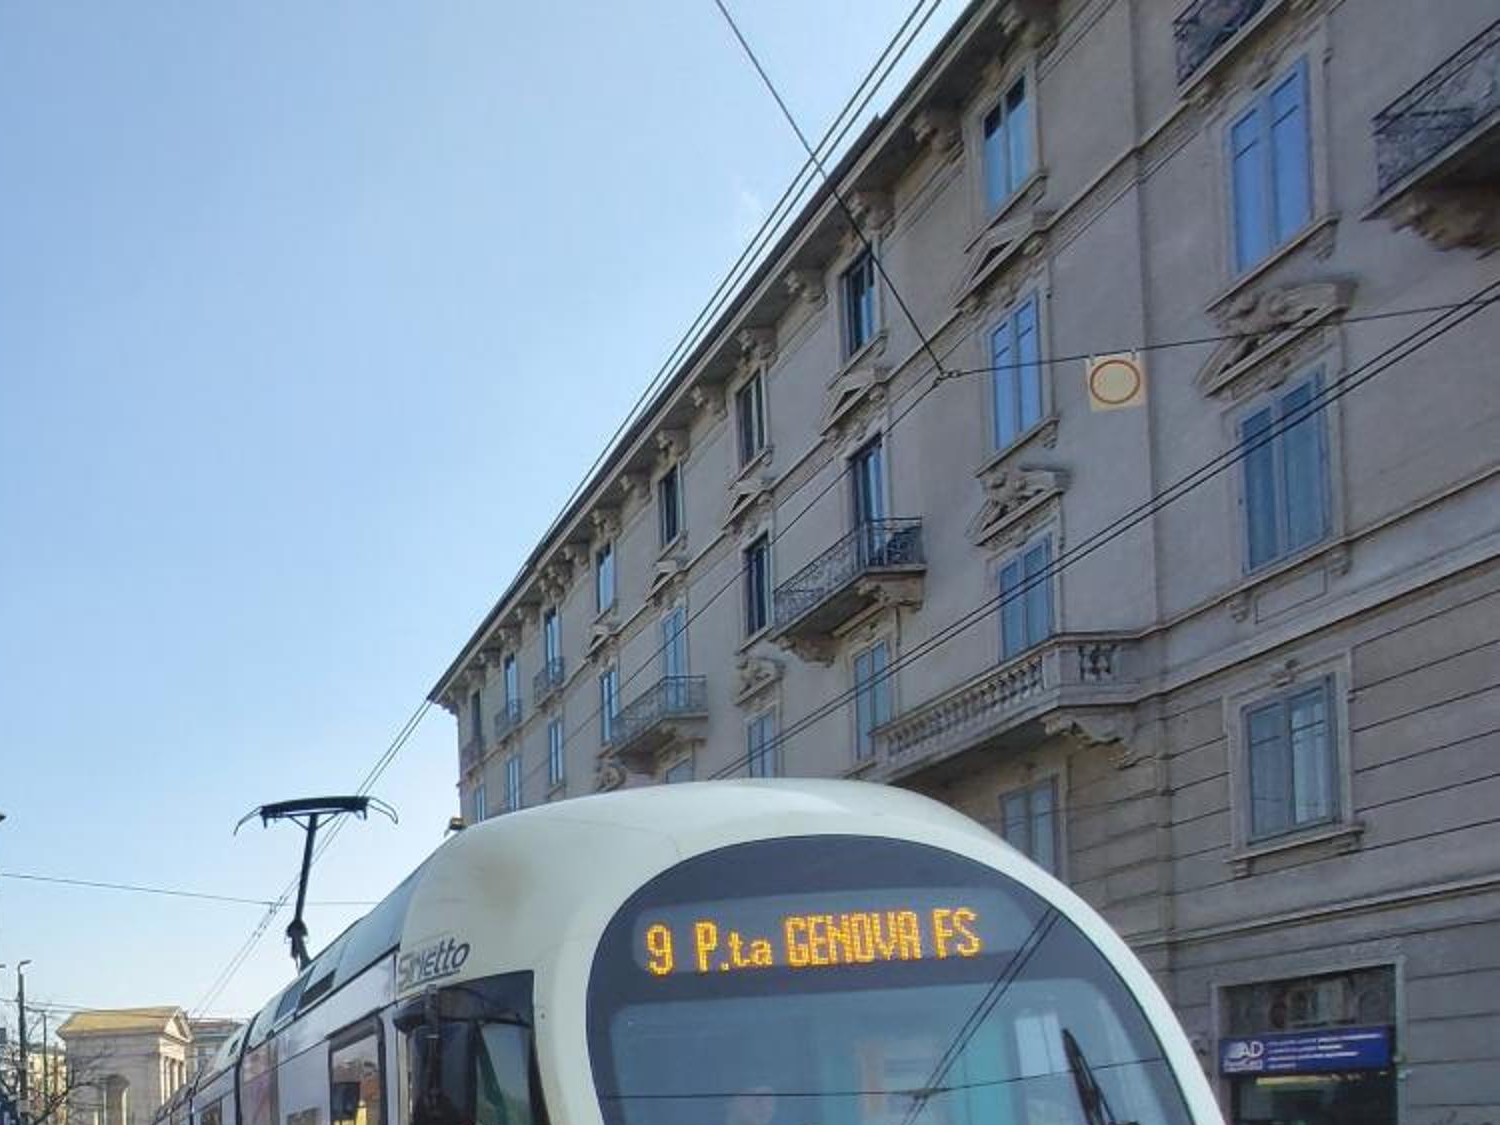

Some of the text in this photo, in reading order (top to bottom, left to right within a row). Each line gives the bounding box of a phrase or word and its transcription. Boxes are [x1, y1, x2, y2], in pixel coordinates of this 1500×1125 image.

[645, 907, 982, 976] 9 P.ta GENOVA FS
